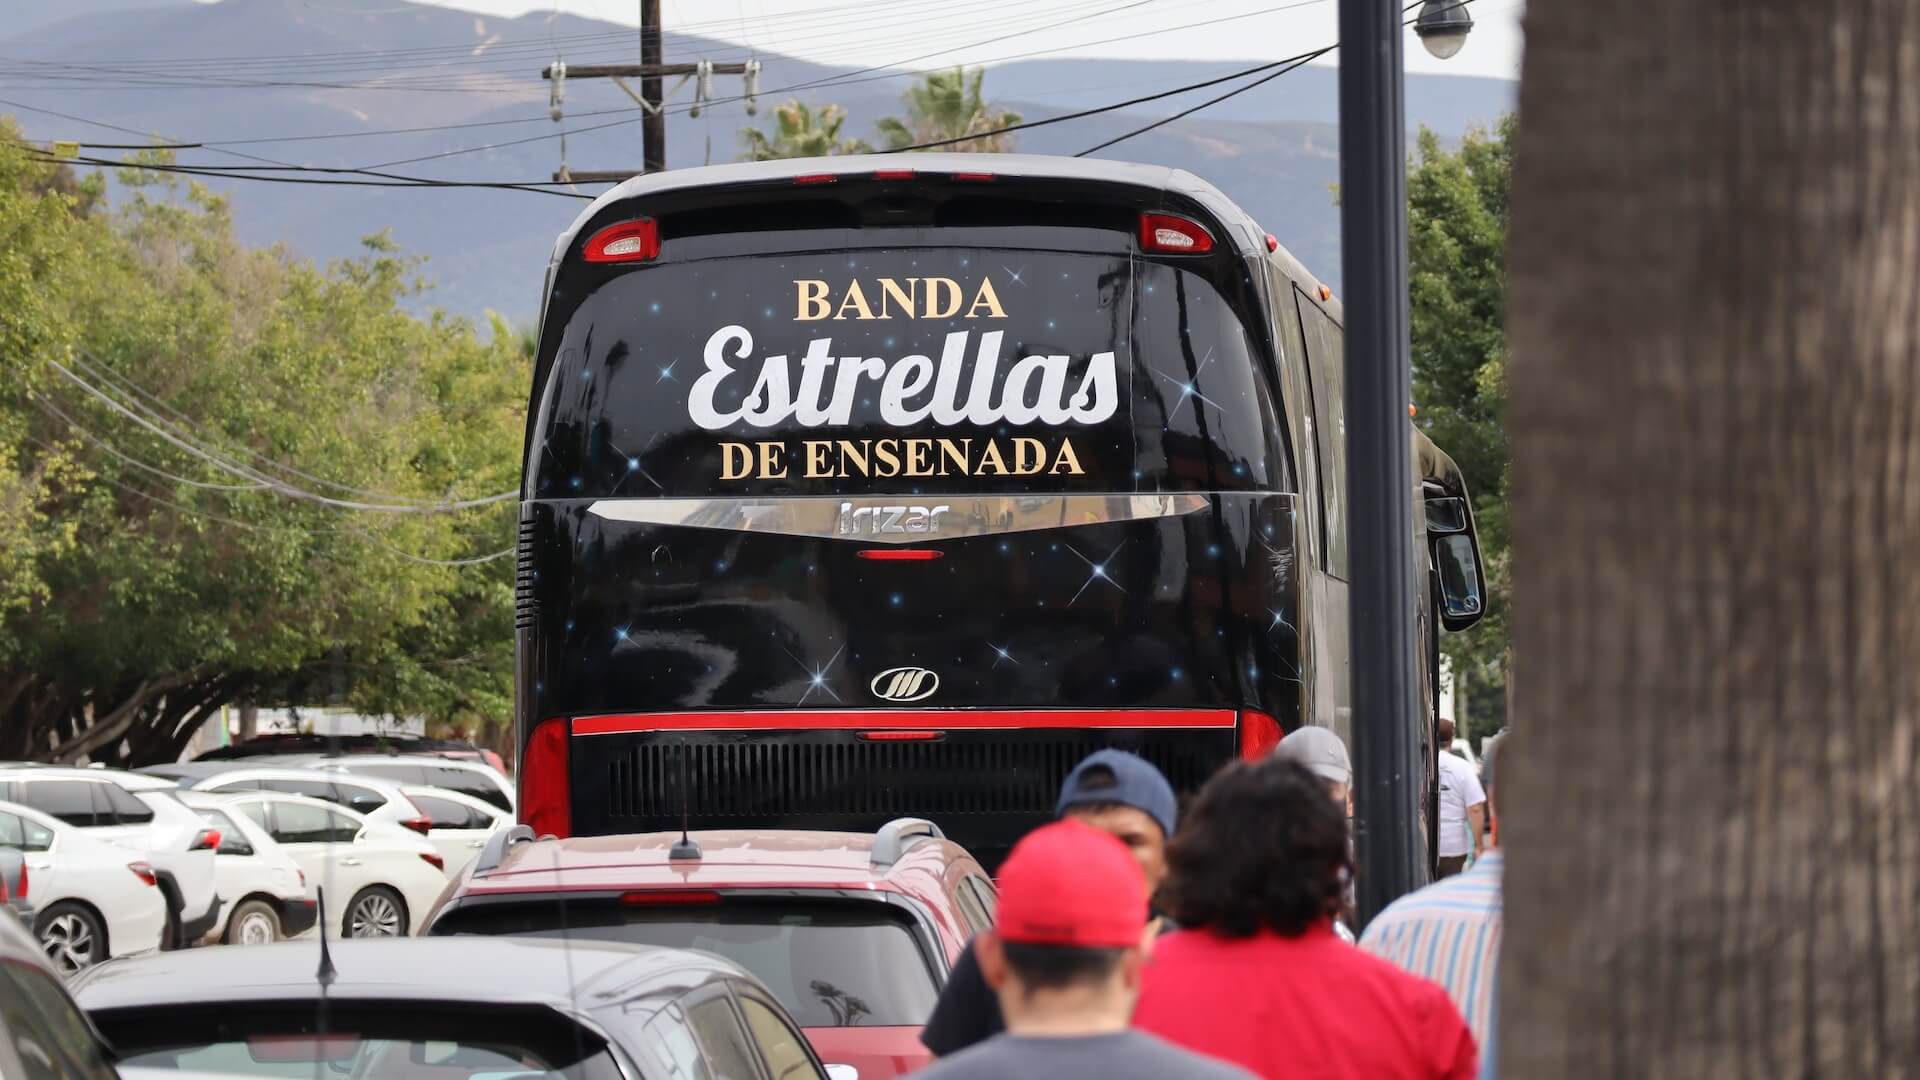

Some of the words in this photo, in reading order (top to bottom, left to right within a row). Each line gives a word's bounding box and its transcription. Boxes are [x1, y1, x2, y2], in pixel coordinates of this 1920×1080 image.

[793, 276, 1008, 321] BANDA
[688, 325, 1119, 430] Estrellas
[718, 441, 788, 480] DE
[802, 436, 1085, 479] ENSENADA
